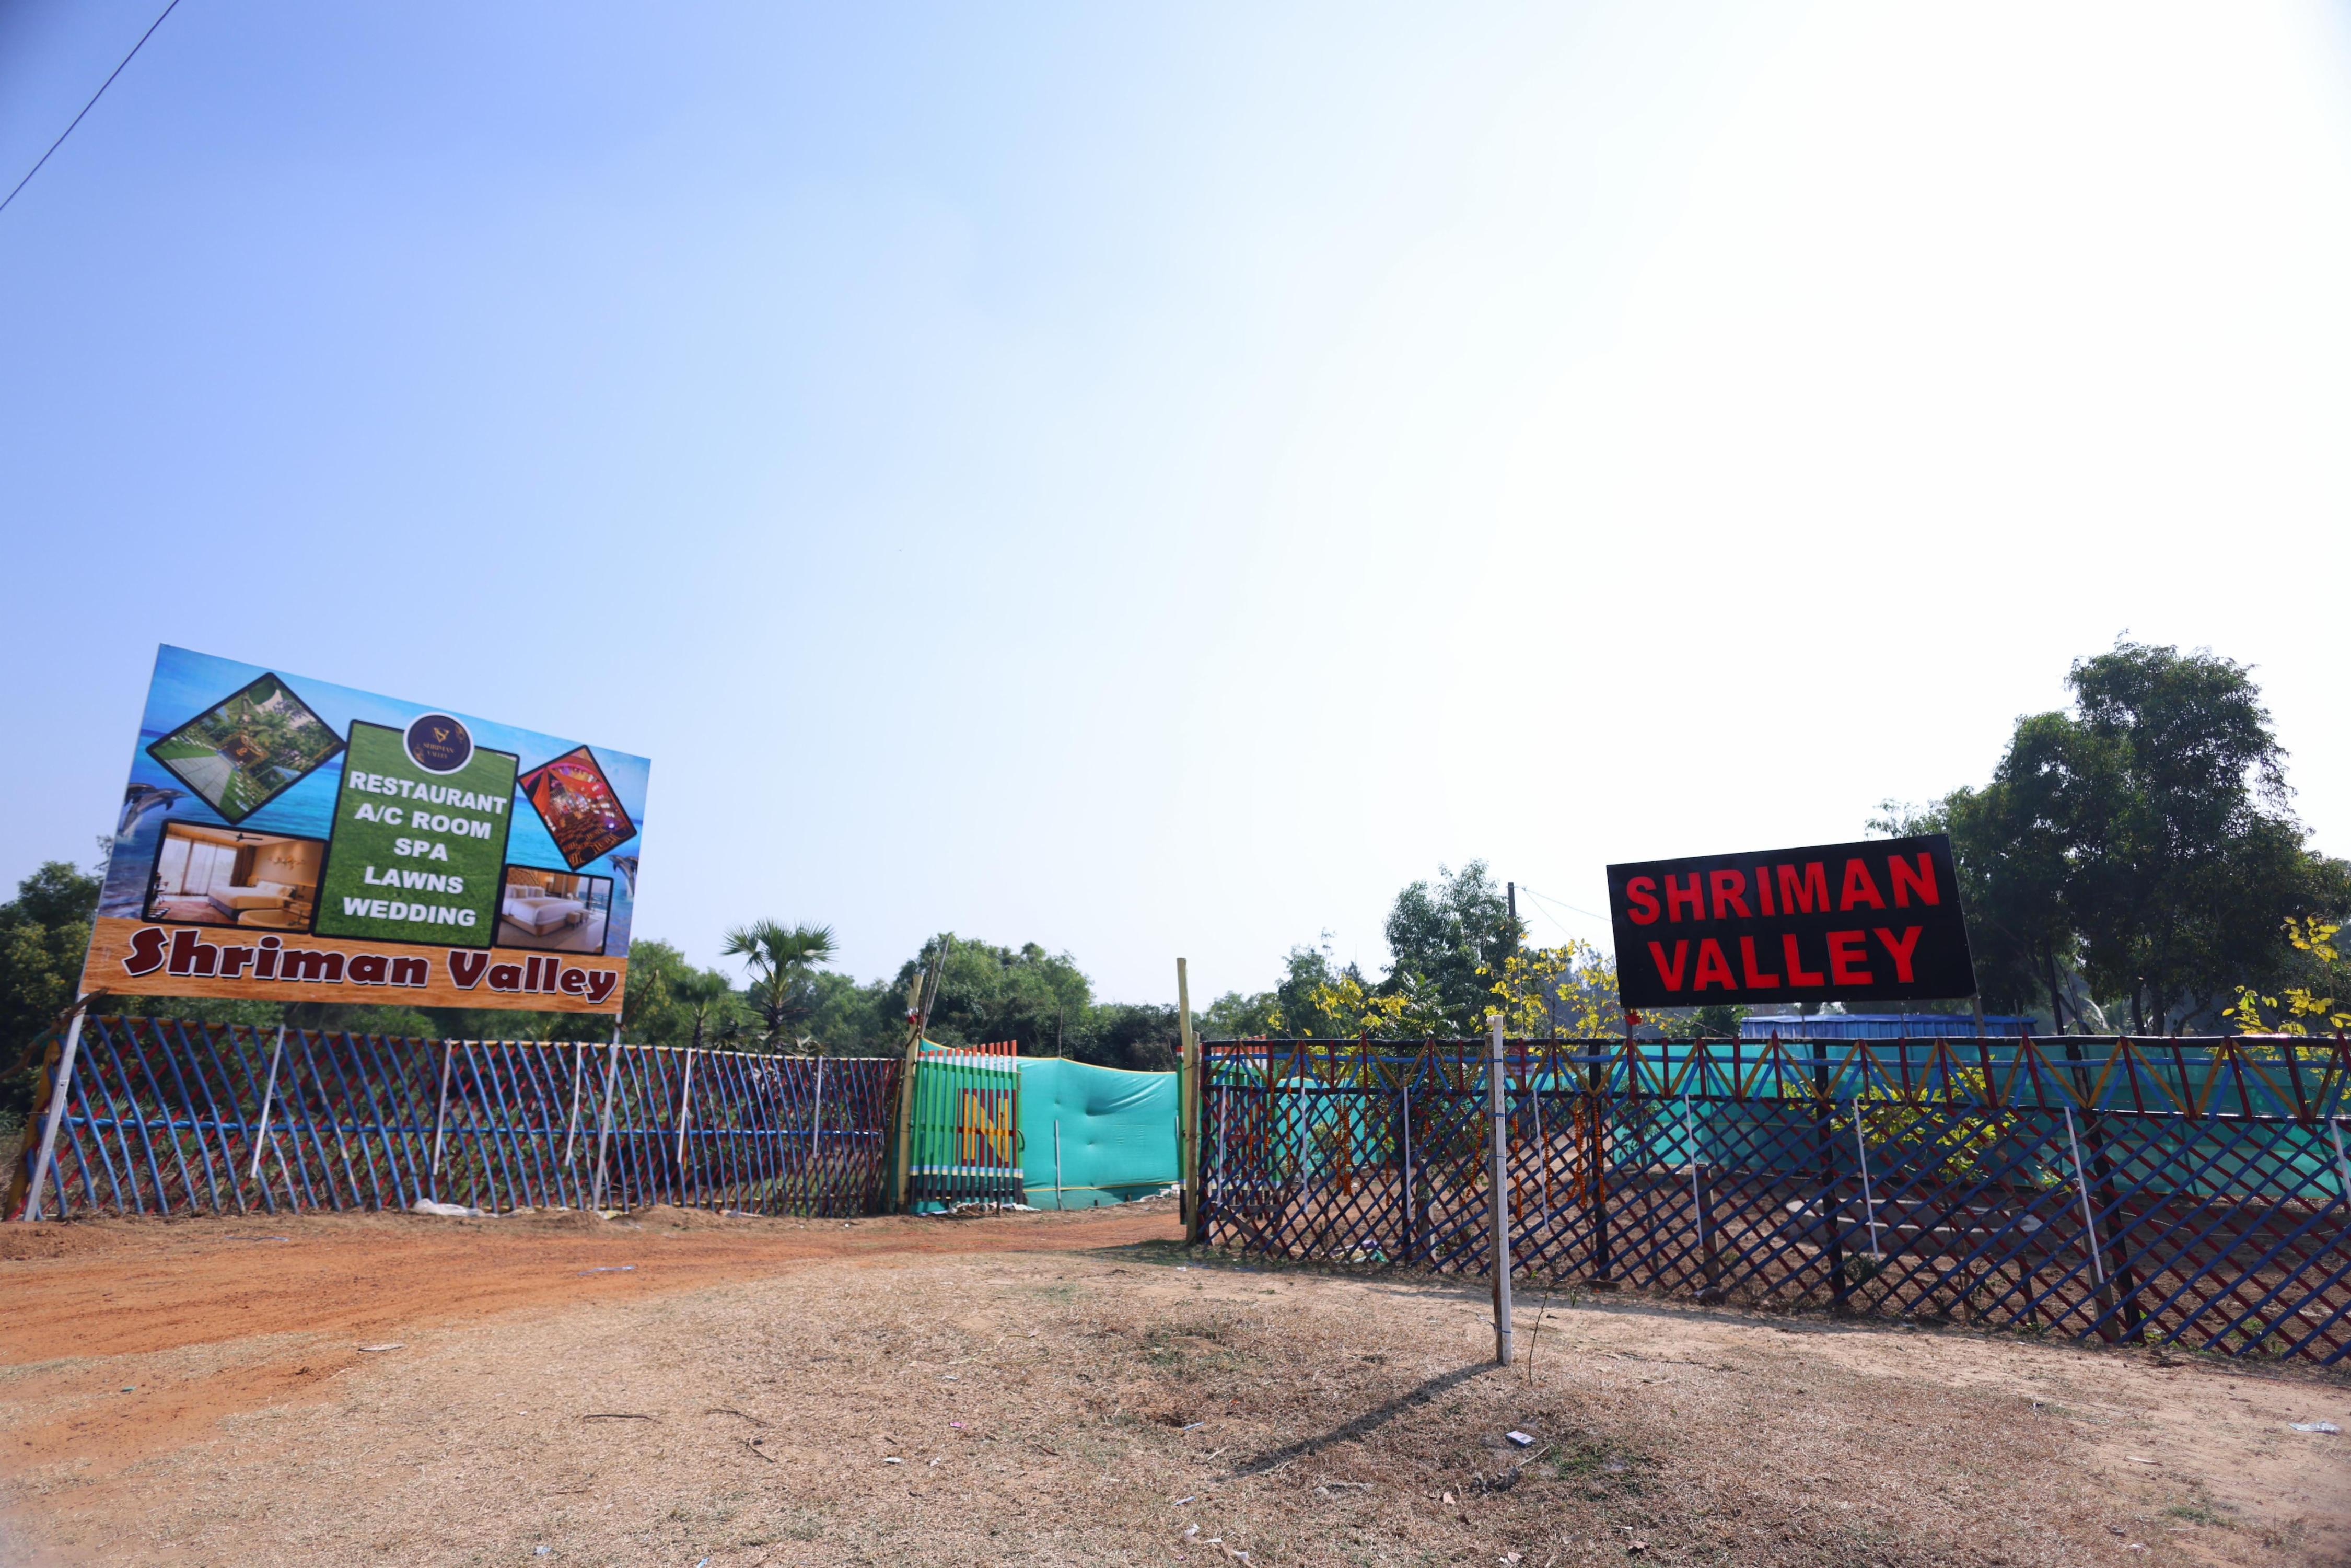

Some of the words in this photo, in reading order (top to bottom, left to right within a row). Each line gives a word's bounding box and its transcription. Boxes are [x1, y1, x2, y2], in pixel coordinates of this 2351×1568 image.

[348, 771, 507, 814] RESTAURANT
[354, 802, 403, 825] A/C
[411, 810, 491, 839] ROOM
[394, 837, 448, 861] SPA
[364, 866, 464, 894] LAWNS
[1626, 852, 1940, 926] SHRIMAN
[343, 897, 476, 926] WEDDING
[122, 927, 430, 988] Shriman
[447, 949, 618, 1004] Valley
[1647, 926, 1923, 991] VALLEY
